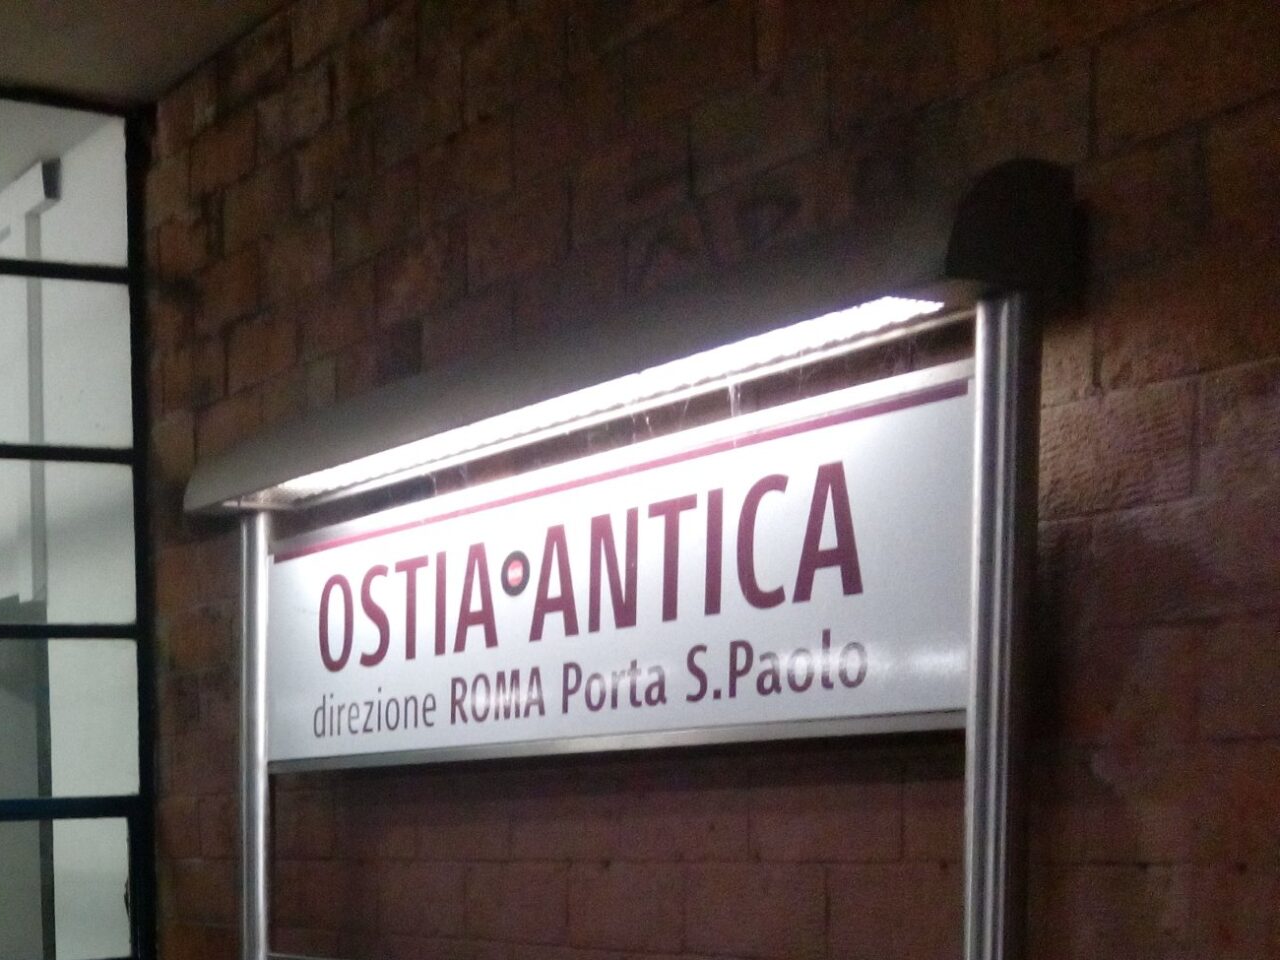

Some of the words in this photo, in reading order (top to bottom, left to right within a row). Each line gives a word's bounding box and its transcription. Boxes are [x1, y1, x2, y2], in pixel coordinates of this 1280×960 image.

[318, 542, 499, 672] OSTIA
[529, 460, 864, 642] ANTICA
[313, 687, 437, 740] direzione
[450, 665, 546, 725] ROMA
[562, 658, 667, 714] Porta
[686, 629, 869, 704] S.Paolo
